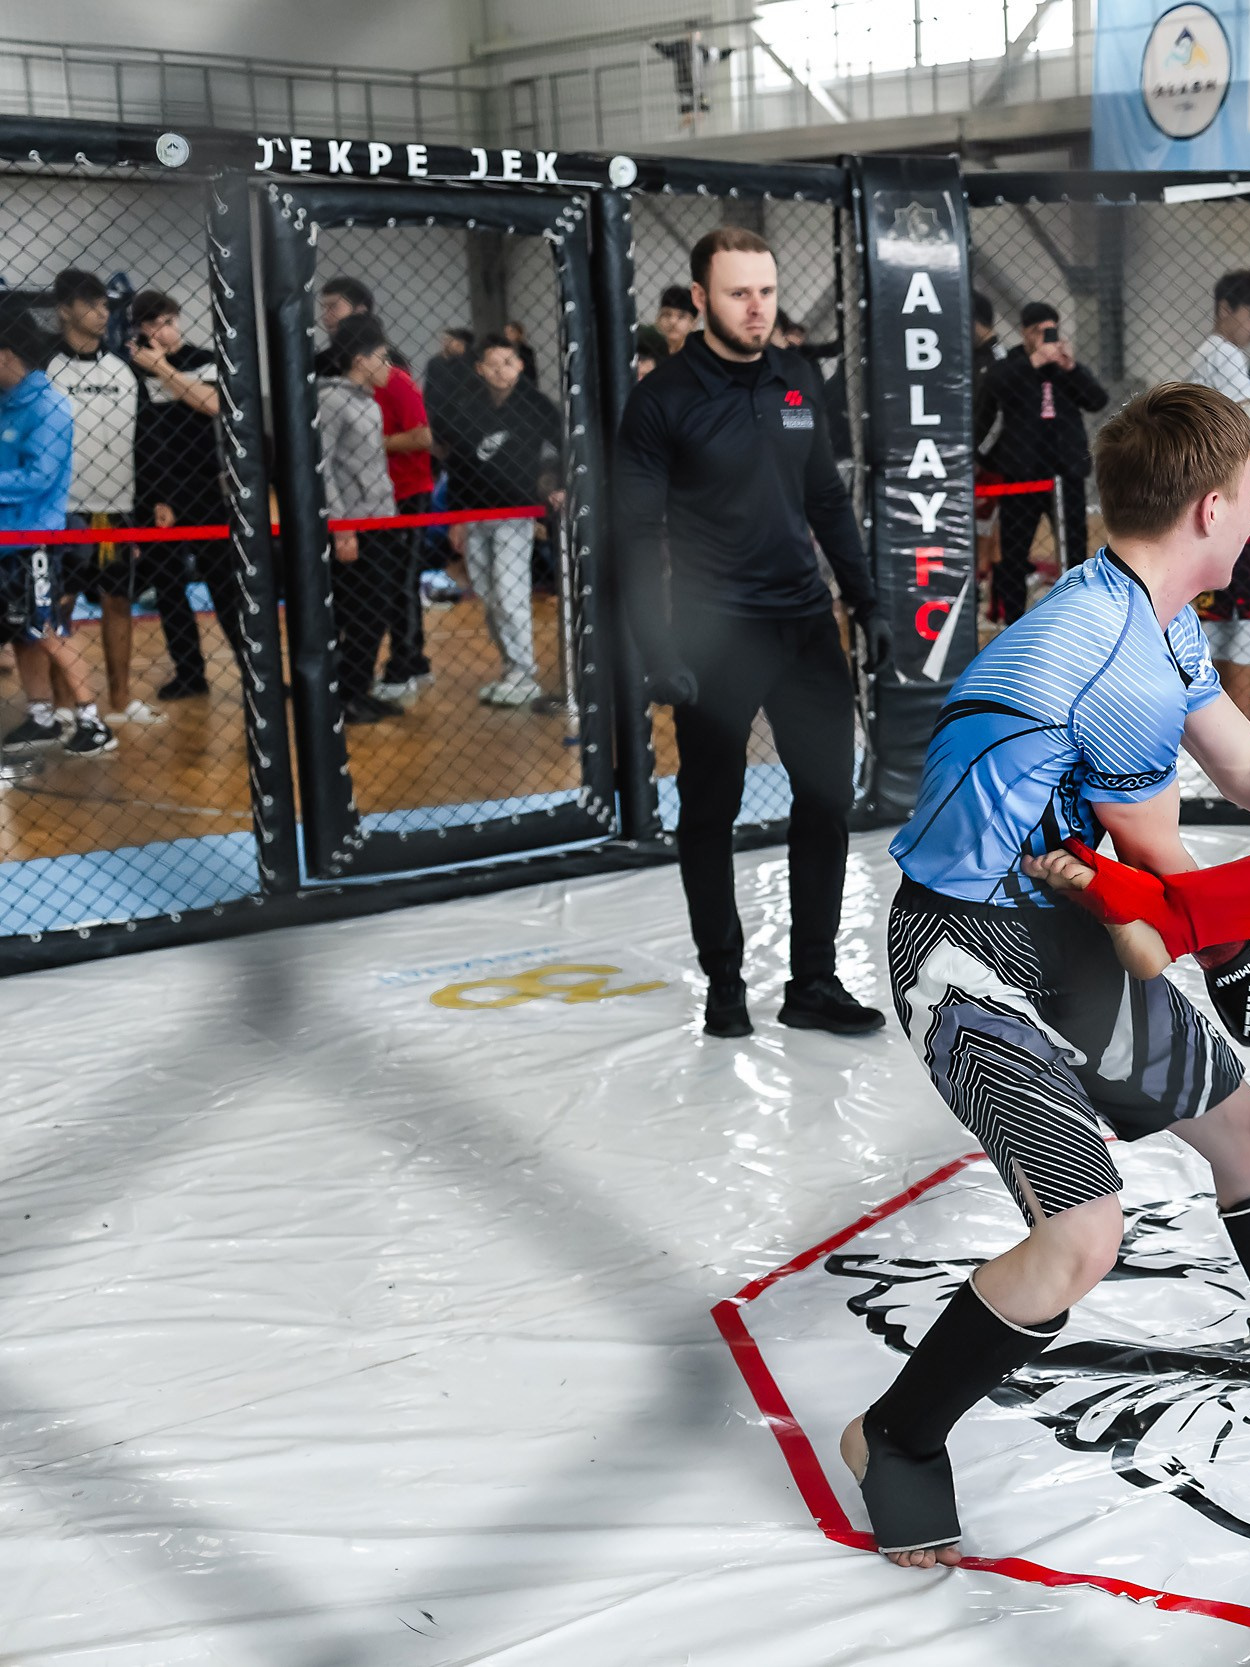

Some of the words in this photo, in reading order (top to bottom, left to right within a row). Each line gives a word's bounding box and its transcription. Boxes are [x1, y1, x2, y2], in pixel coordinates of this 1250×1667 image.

[254, 136, 429, 178] JEKPE
[469, 147, 559, 183] JEK
[902, 272, 947, 533] ABLAY
[914, 547, 950, 641] FC
